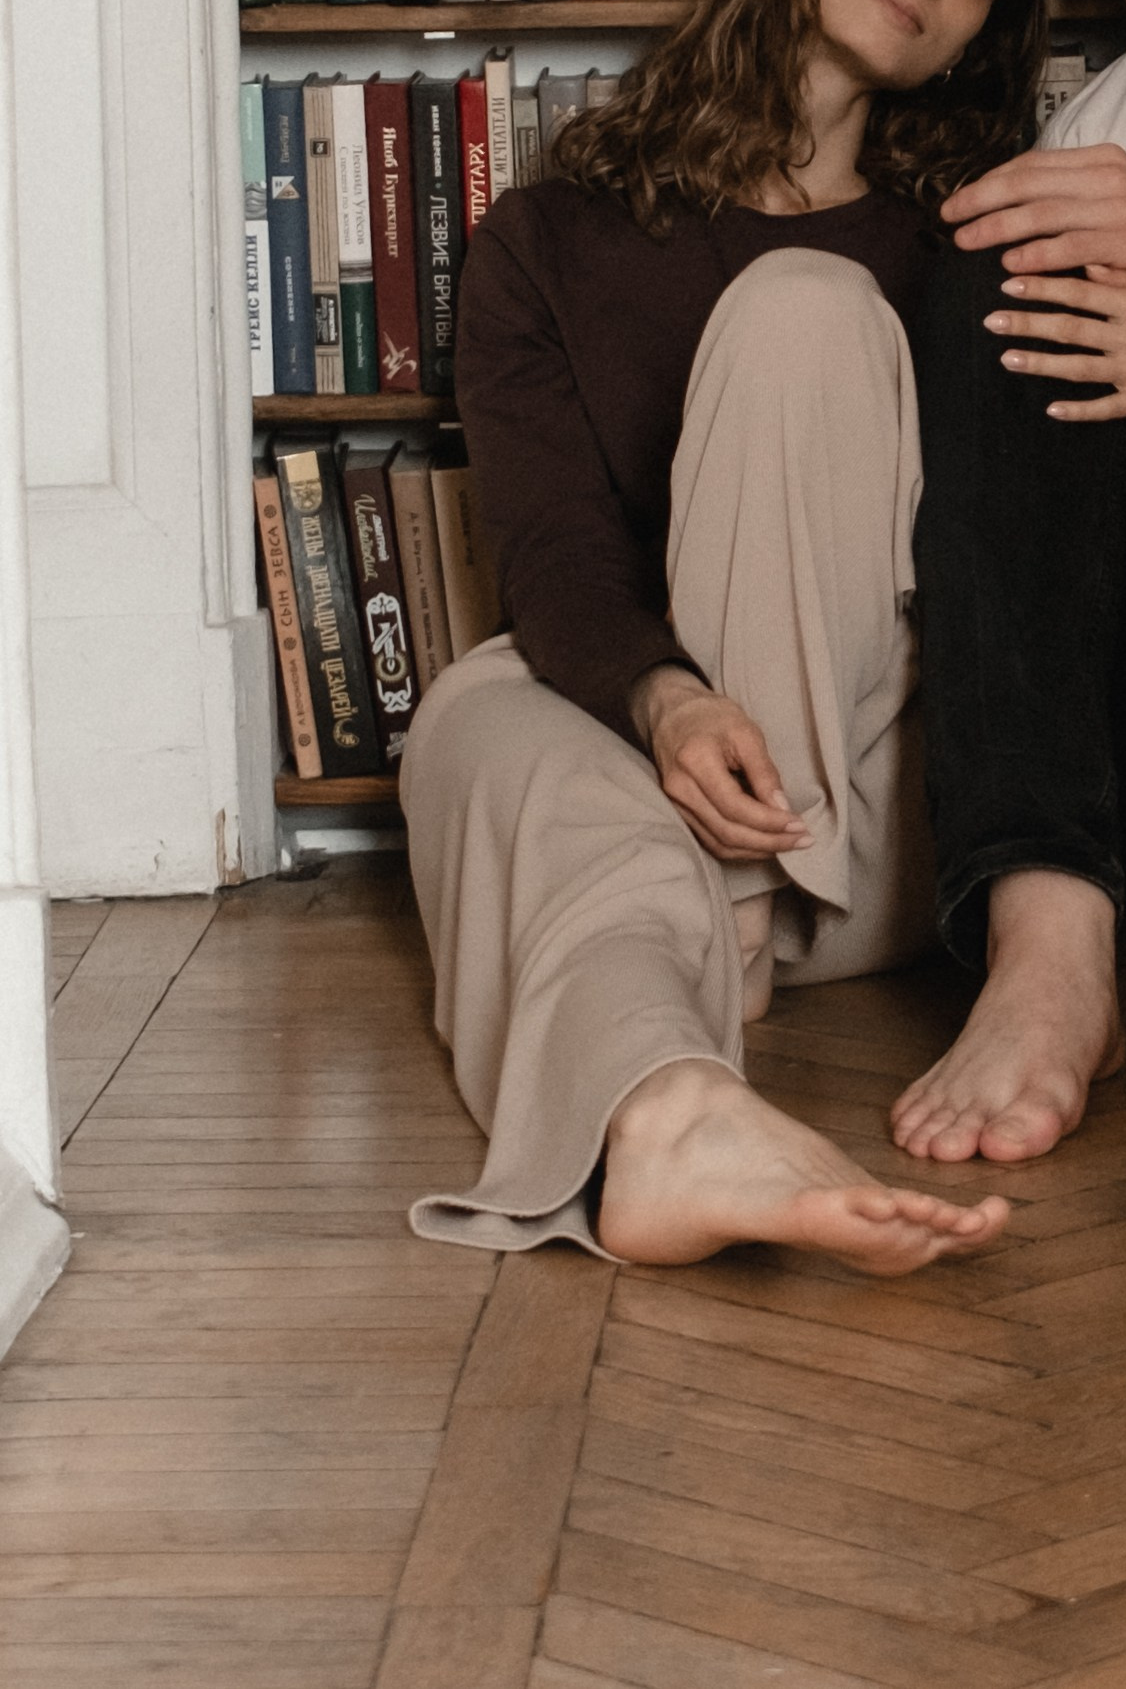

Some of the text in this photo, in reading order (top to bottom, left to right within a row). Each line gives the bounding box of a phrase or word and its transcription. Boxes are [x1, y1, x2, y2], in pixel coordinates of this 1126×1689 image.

[431, 104, 441, 132] ИВАН
[490, 97, 508, 176] МЕЧТАТЕЛИ
[351, 143, 365, 196] Леонид
[383, 126, 400, 258] Якоб Буркхардт
[468, 142, 486, 225] ПЛУТАРХ
[245, 234, 259, 292] КЕЛЛИ
[429, 194, 452, 347] ЛЕЗВИЕ БРИТВЫ
[266, 525, 286, 578] ЗЕВСА
[277, 589, 294, 627] СЫН
[300, 514, 359, 719] ЖЕНЫ ДВЕНАДЦАТИ ЦЕЗАРЕЙ
